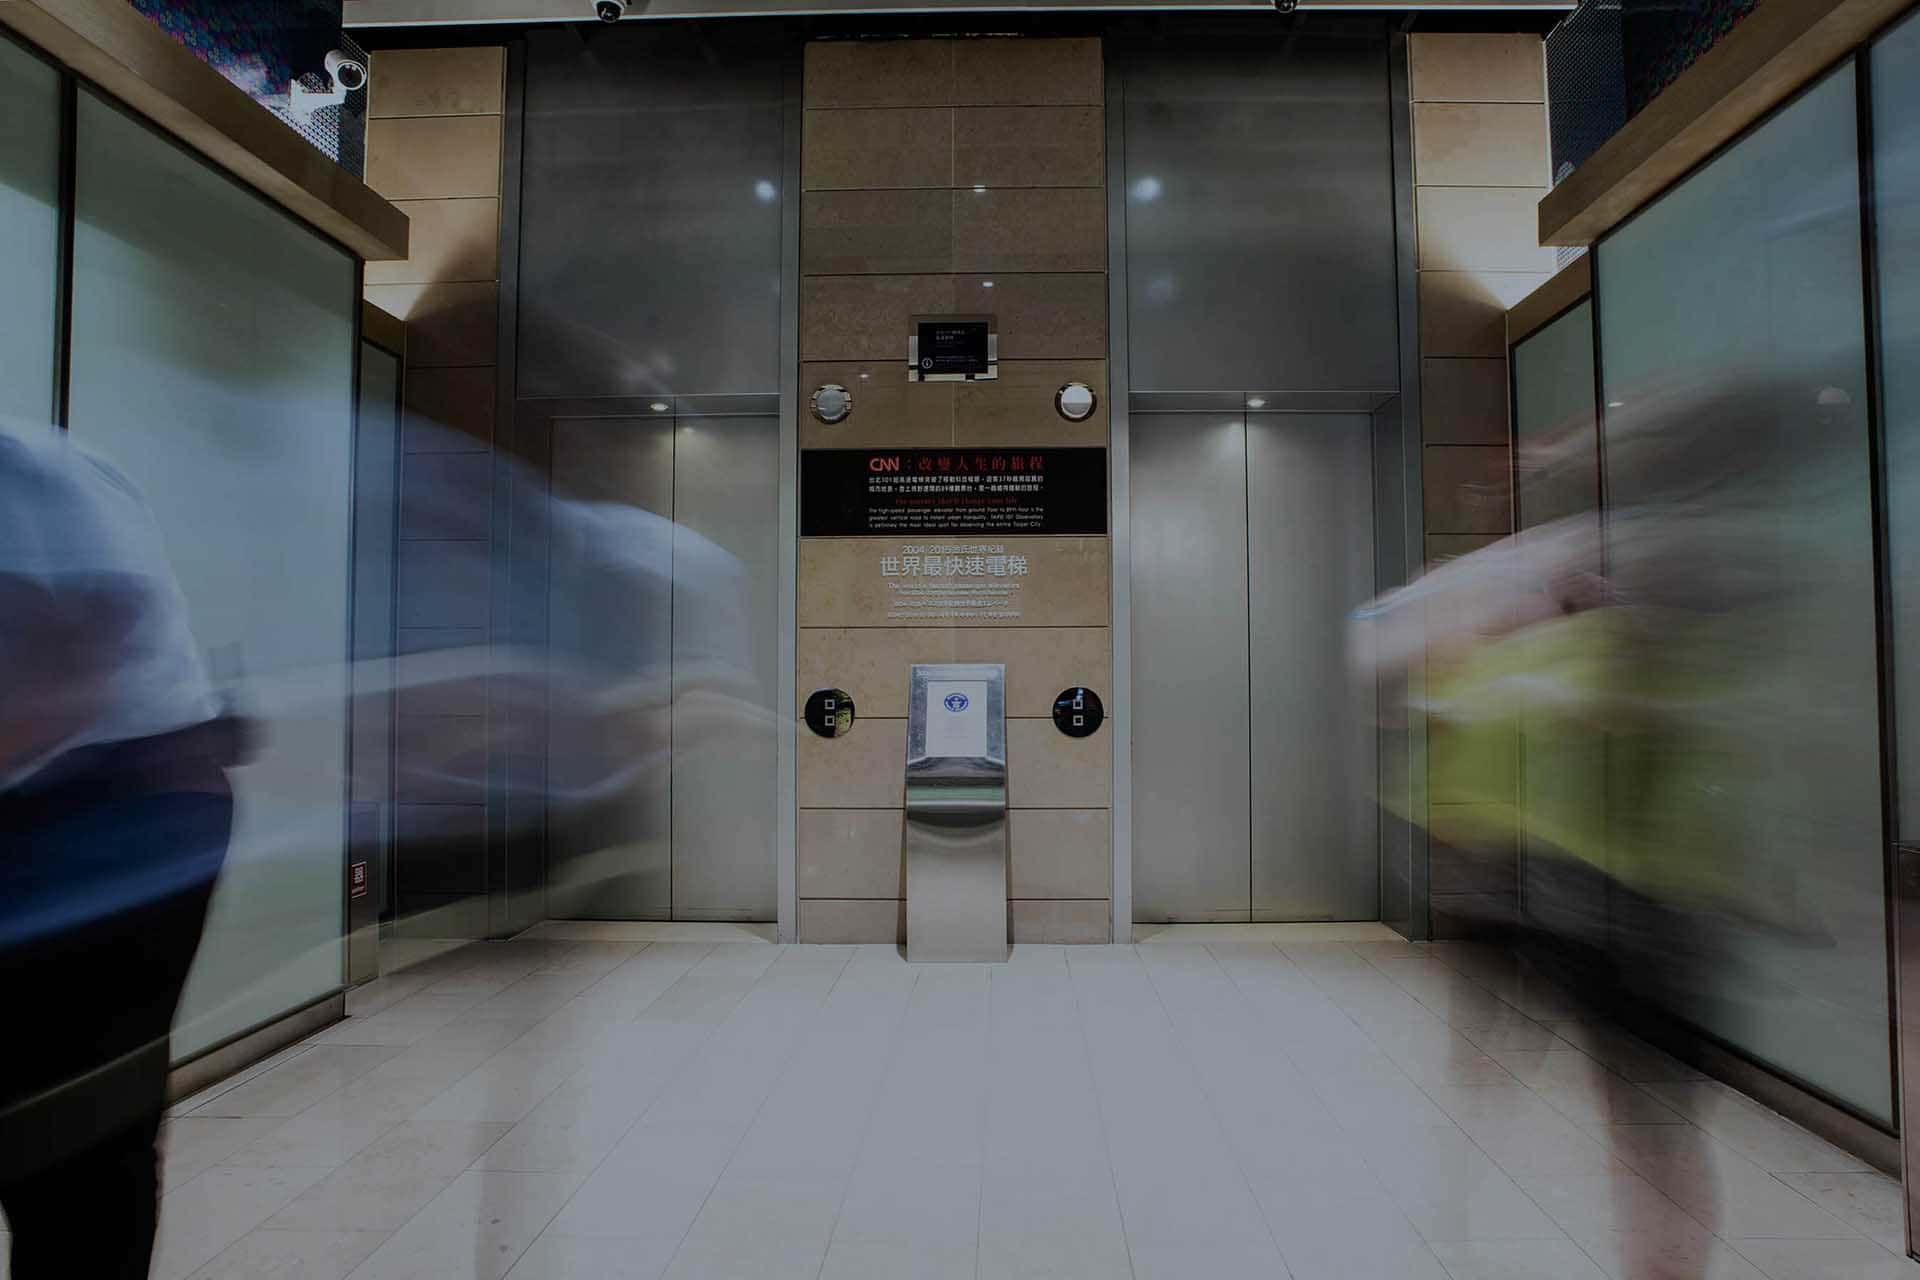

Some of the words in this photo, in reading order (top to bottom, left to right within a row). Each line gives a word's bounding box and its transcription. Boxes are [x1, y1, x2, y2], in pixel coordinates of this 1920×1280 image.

[880, 555, 1028, 576] 世界最快速電梯
